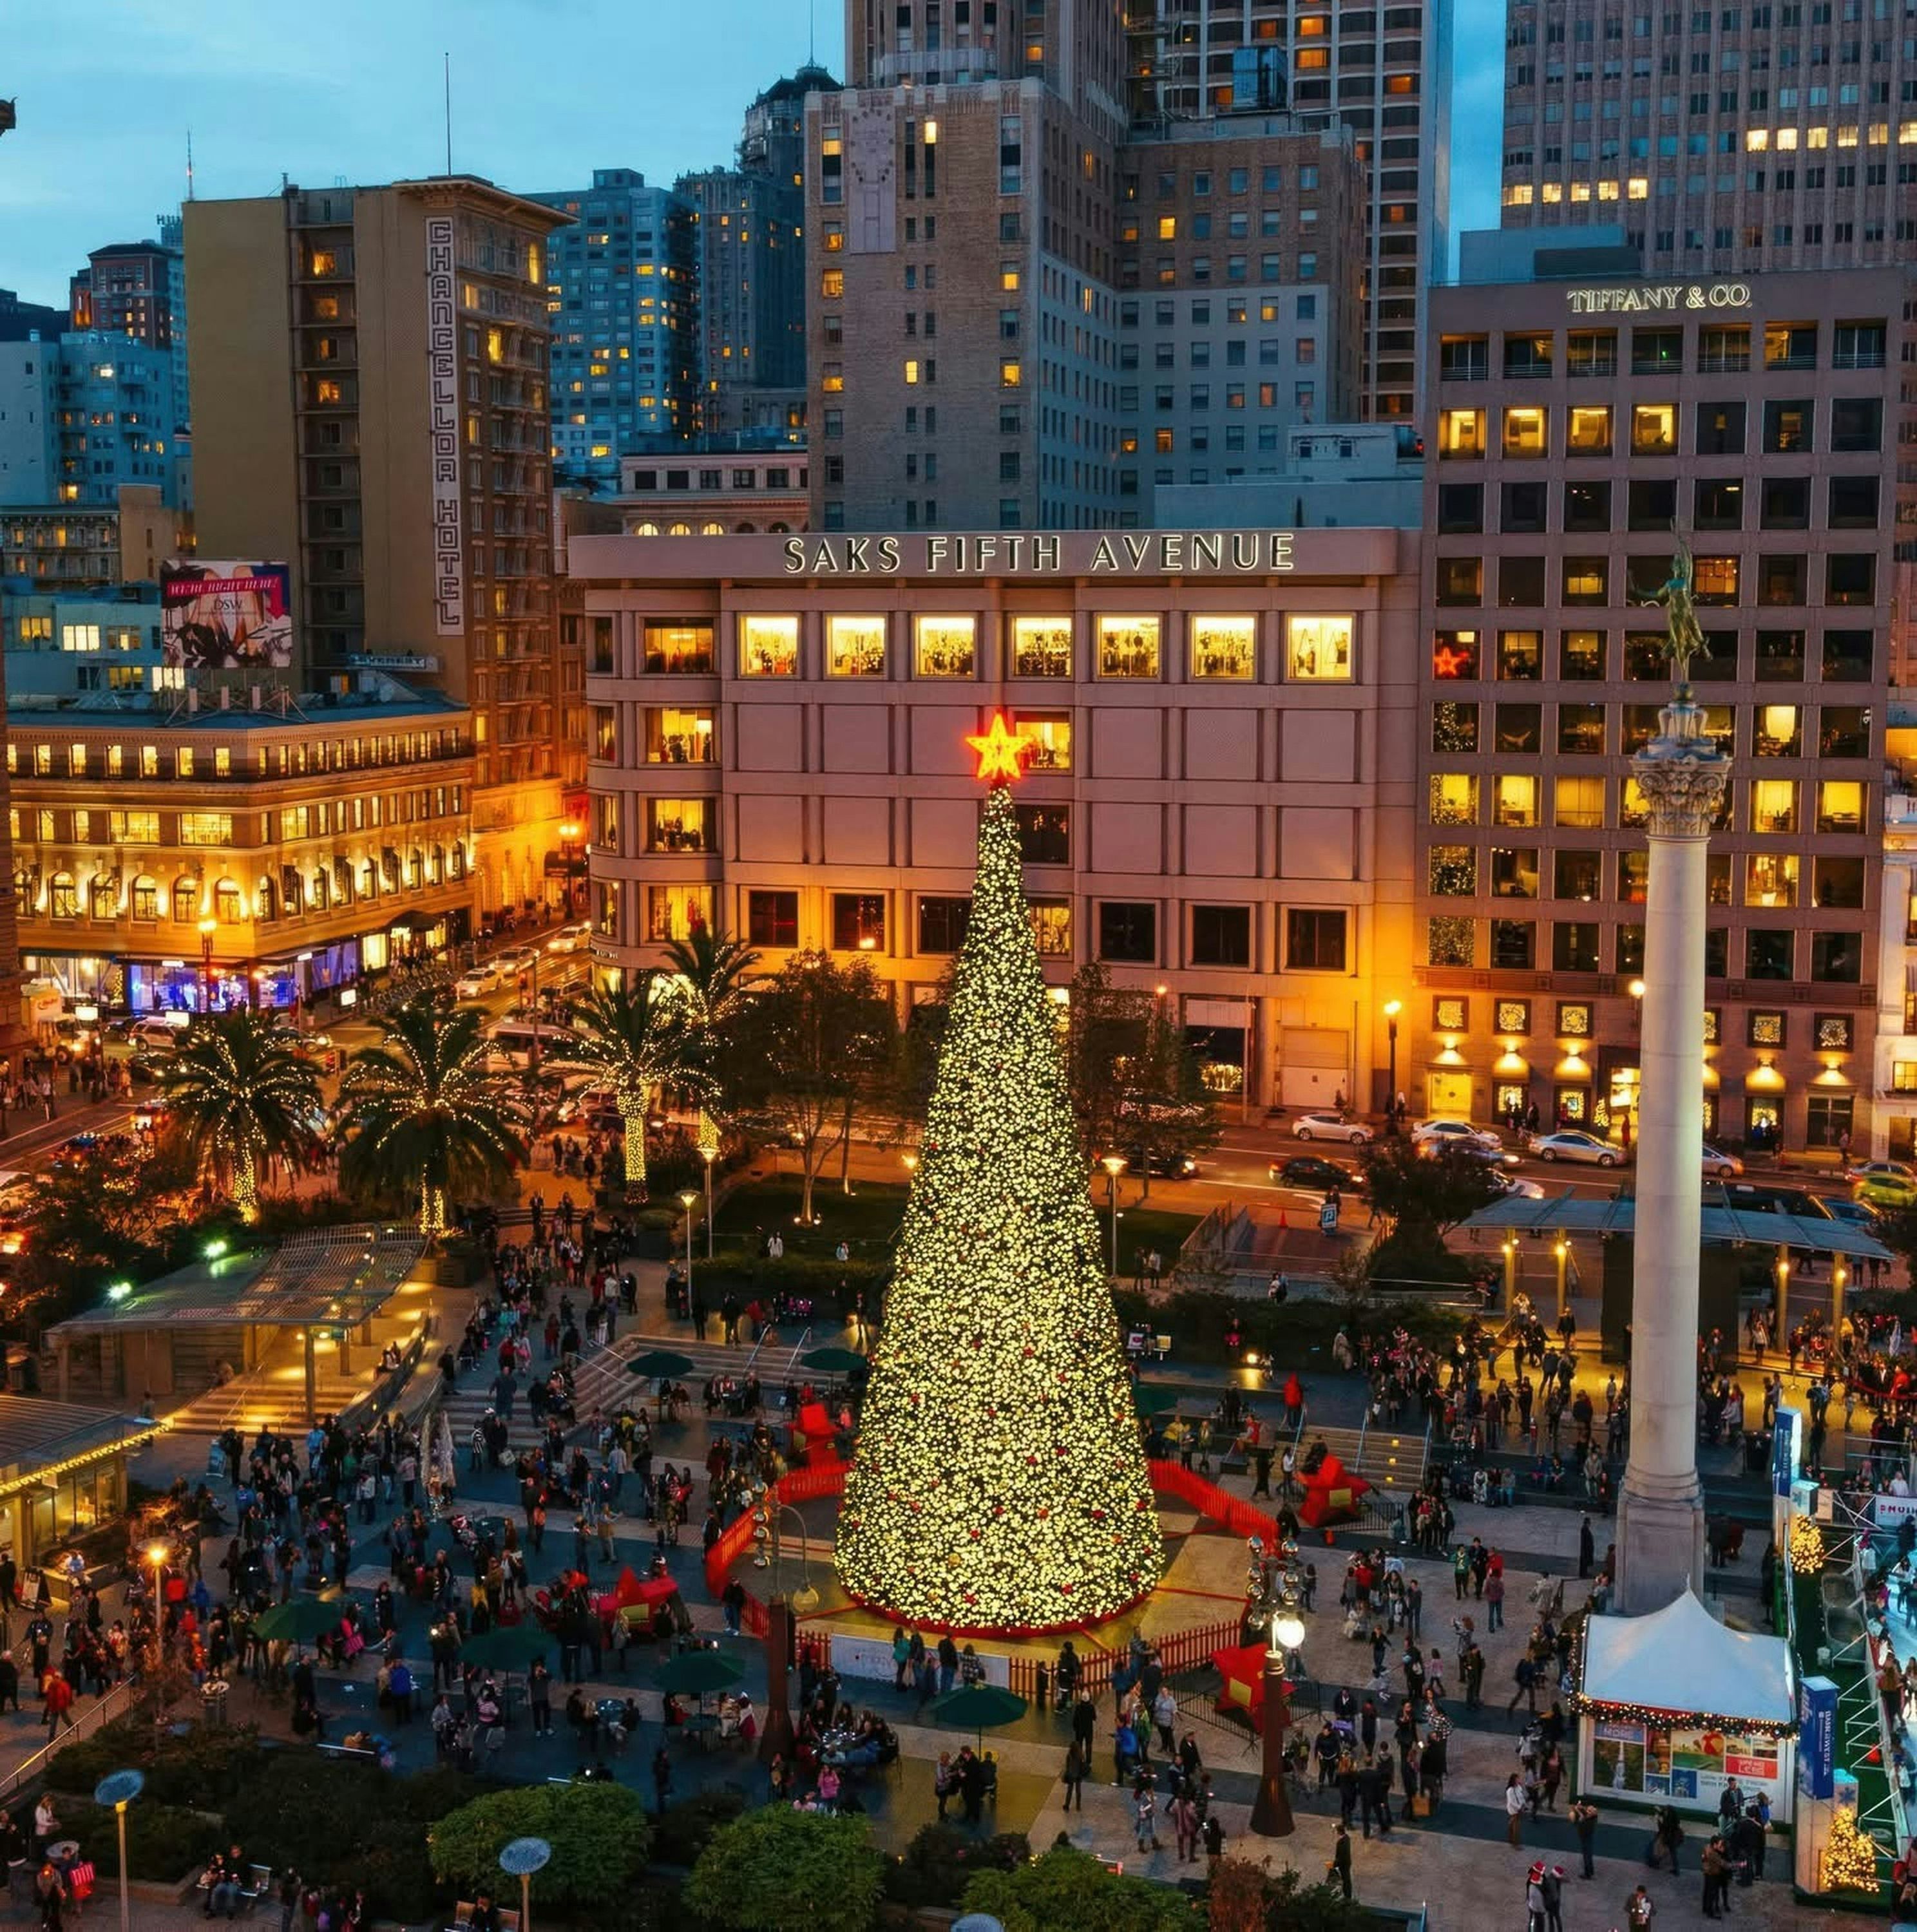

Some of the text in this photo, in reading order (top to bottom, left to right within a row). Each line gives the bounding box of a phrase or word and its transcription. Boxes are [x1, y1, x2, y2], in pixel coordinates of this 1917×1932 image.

[1566, 286, 1683, 313] TIFFANY
[1685, 285, 1706, 309] &
[429, 222, 461, 625] CHANCELLOR HOTEL
[783, 533, 1295, 573] SAKS FIFTH AVENUE
[213, 598, 243, 611] DSW
